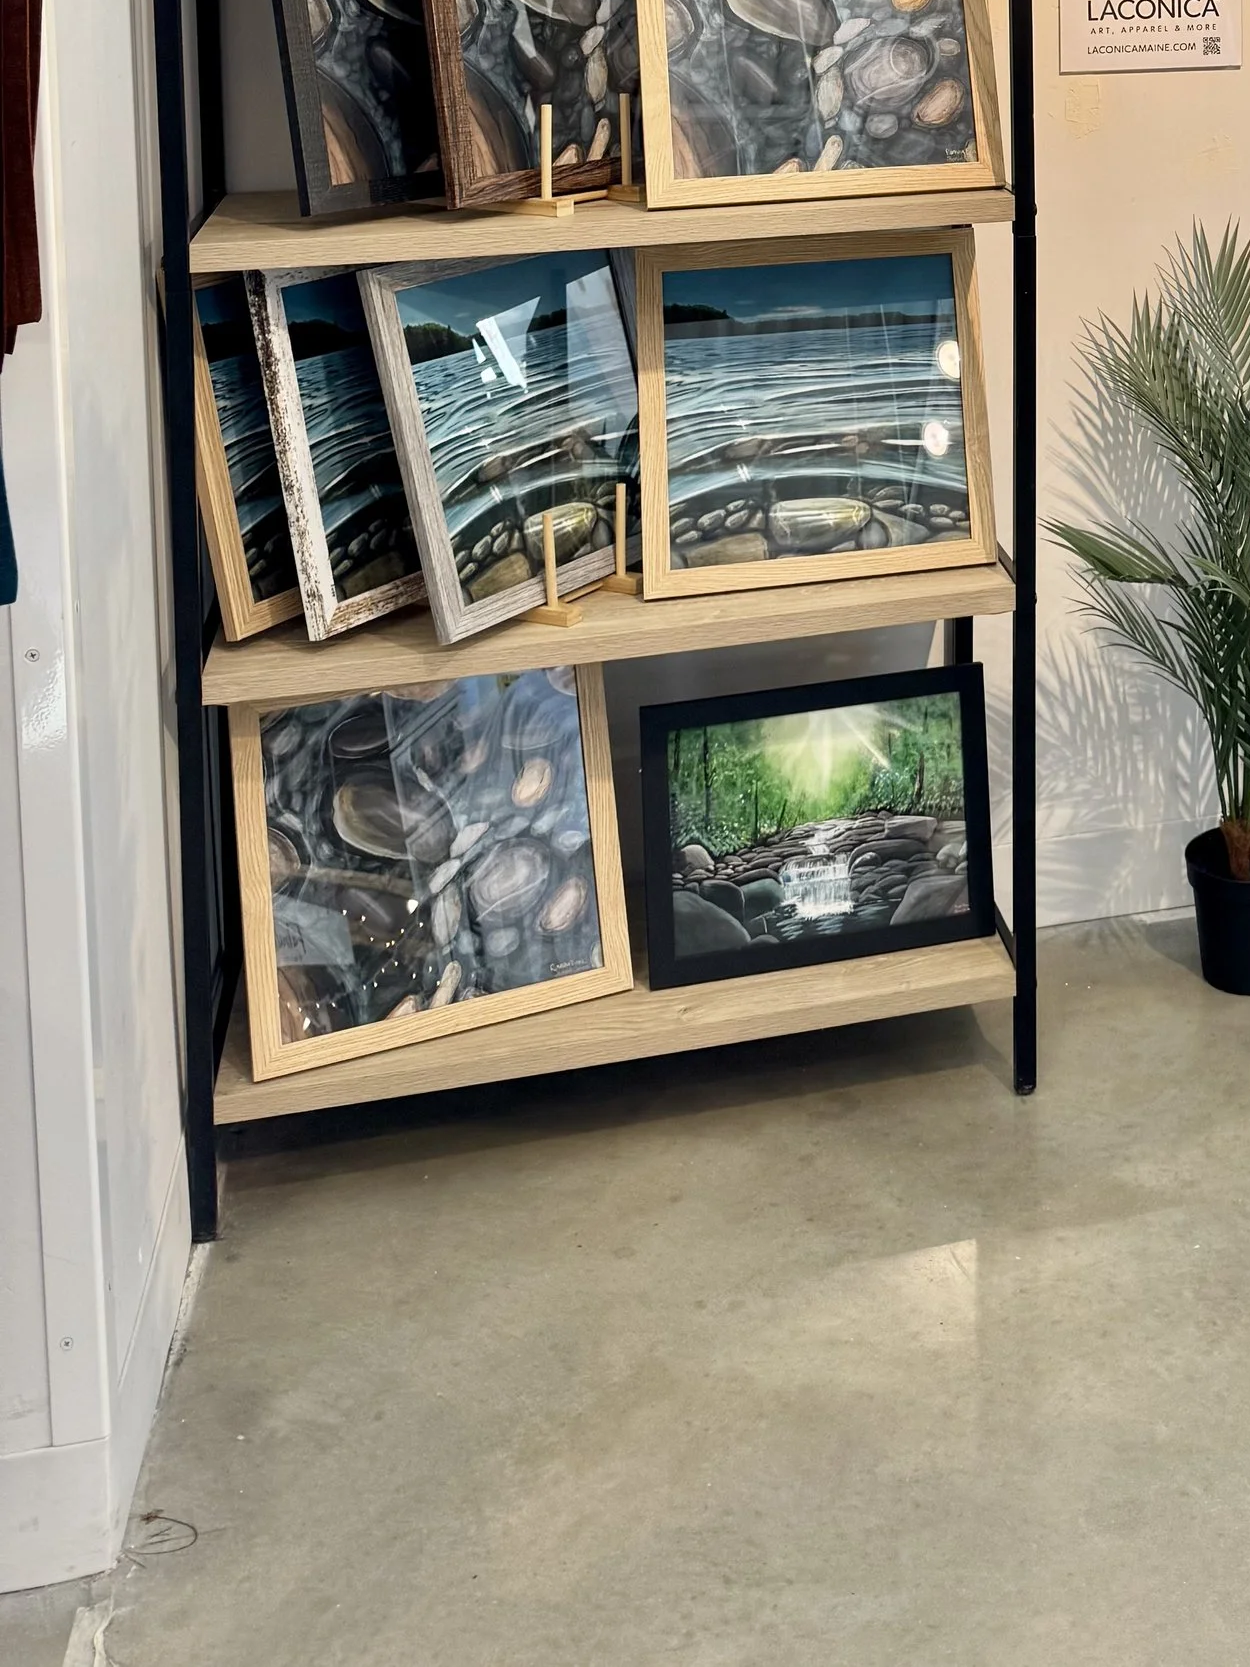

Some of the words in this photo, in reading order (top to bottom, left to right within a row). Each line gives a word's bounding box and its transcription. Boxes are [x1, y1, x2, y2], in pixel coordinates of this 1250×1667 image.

[1090, 27, 1115, 35] ART,
[1121, 25, 1169, 33] APPAREL
[1087, 43, 1197, 55] LACONICAMAINE.COM
